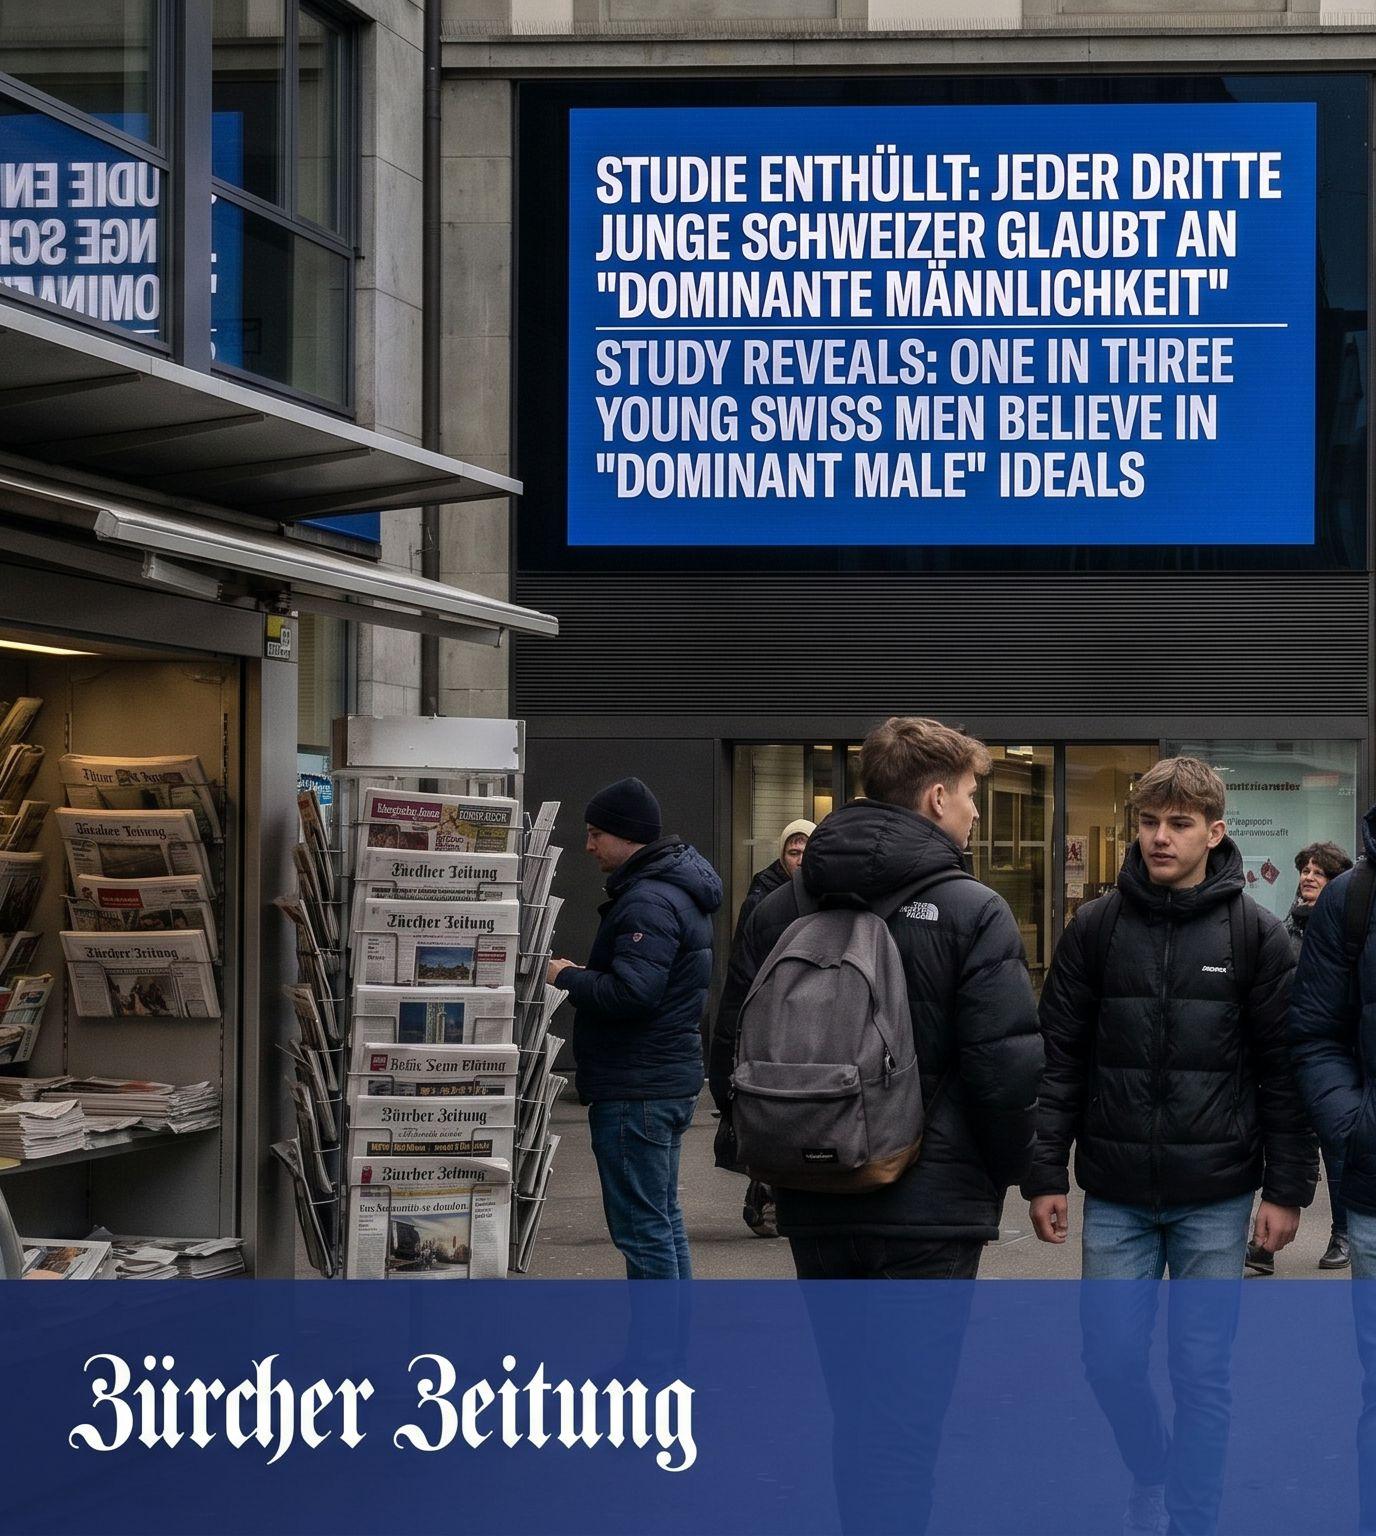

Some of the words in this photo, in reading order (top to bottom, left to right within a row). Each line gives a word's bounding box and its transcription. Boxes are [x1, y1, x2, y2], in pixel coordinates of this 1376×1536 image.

[596, 155, 747, 204] STUDIE
[760, 144, 980, 202] ENTHÜLLT:
[991, 153, 1120, 201] JEDER
[1132, 151, 1282, 200] DRITTE
[595, 213, 730, 261] JUNGE
[741, 212, 986, 260] SCHWEIZER
[997, 210, 1166, 259] GLAUBT
[1176, 210, 1236, 257] AN
[597, 270, 873, 319] "DOMINANTE
[886, 260, 1229, 318] MÄNNLICHKEIT"
[596, 339, 732, 386] STUDY
[744, 338, 937, 385] REVEALS:
[950, 338, 1035, 385] ONE
[1048, 338, 1089, 384] IN
[1101, 337, 1234, 383] THREE
[595, 395, 738, 442] YOUNG
[750, 395, 883, 442] SWISS
[896, 395, 984, 441] MEN
[999, 395, 1163, 441] BELIEVE
[1176, 394, 1217, 440] IN
[596, 452, 843, 499] "DOMINANT
[855, 452, 986, 498] MALE"
[1000, 451, 1145, 498] IDEALS
